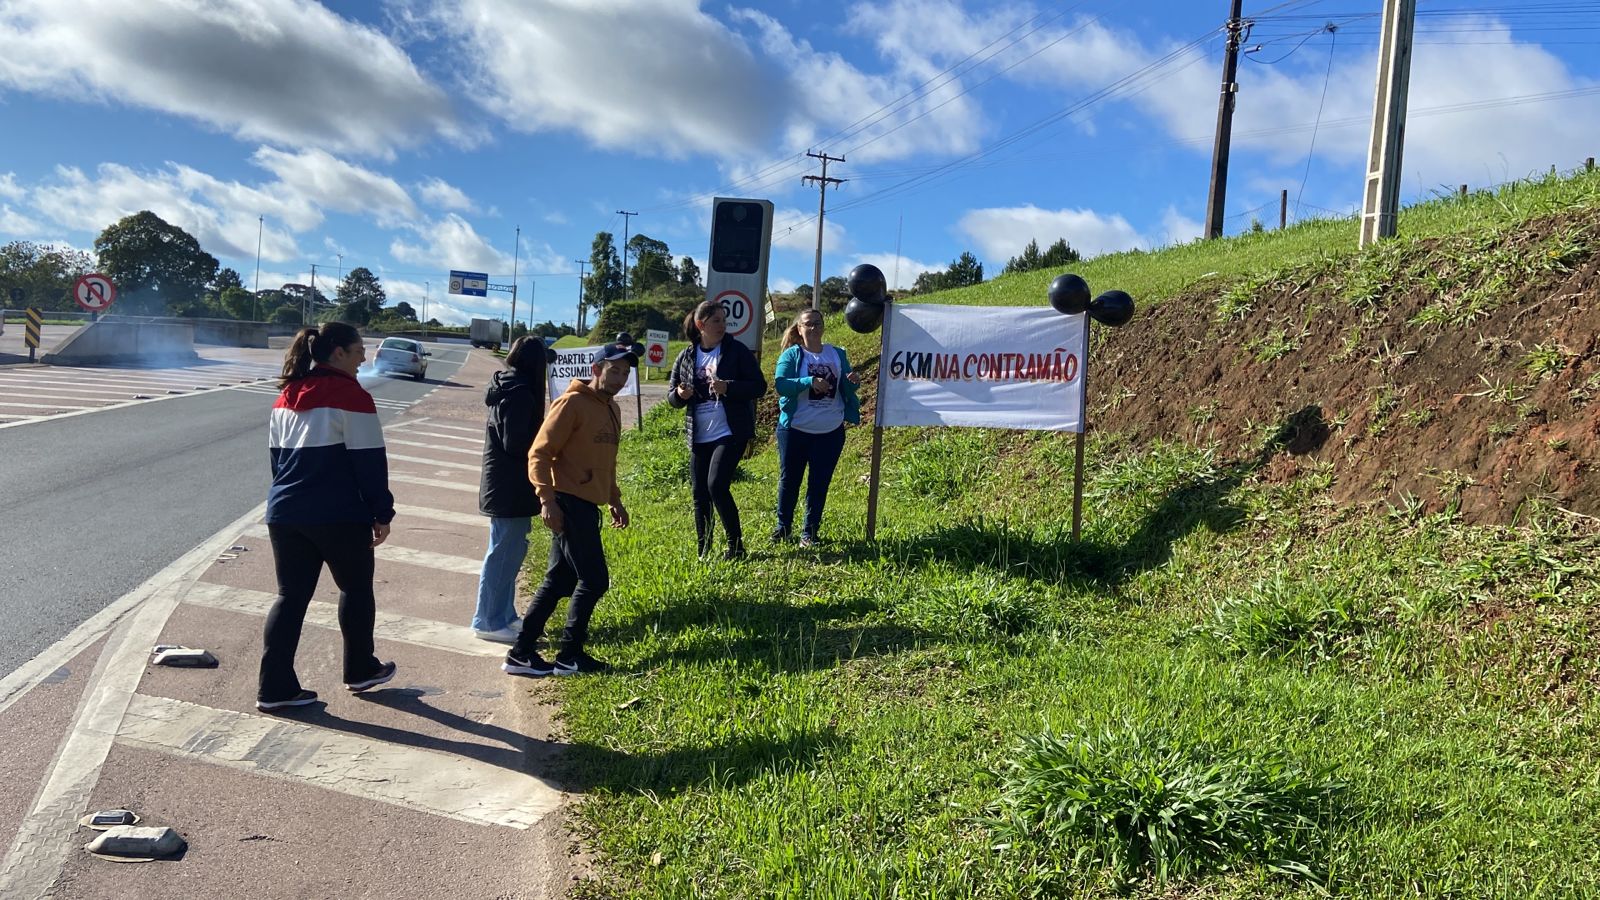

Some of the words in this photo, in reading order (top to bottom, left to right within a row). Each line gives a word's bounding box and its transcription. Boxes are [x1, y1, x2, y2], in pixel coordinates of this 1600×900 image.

[558, 353, 586, 365] PARTIR
[890, 350, 933, 378] 6KM
[933, 353, 960, 379] NA
[963, 347, 1078, 381] CONTRAMÃO
[551, 366, 593, 378] ASSUMIU
